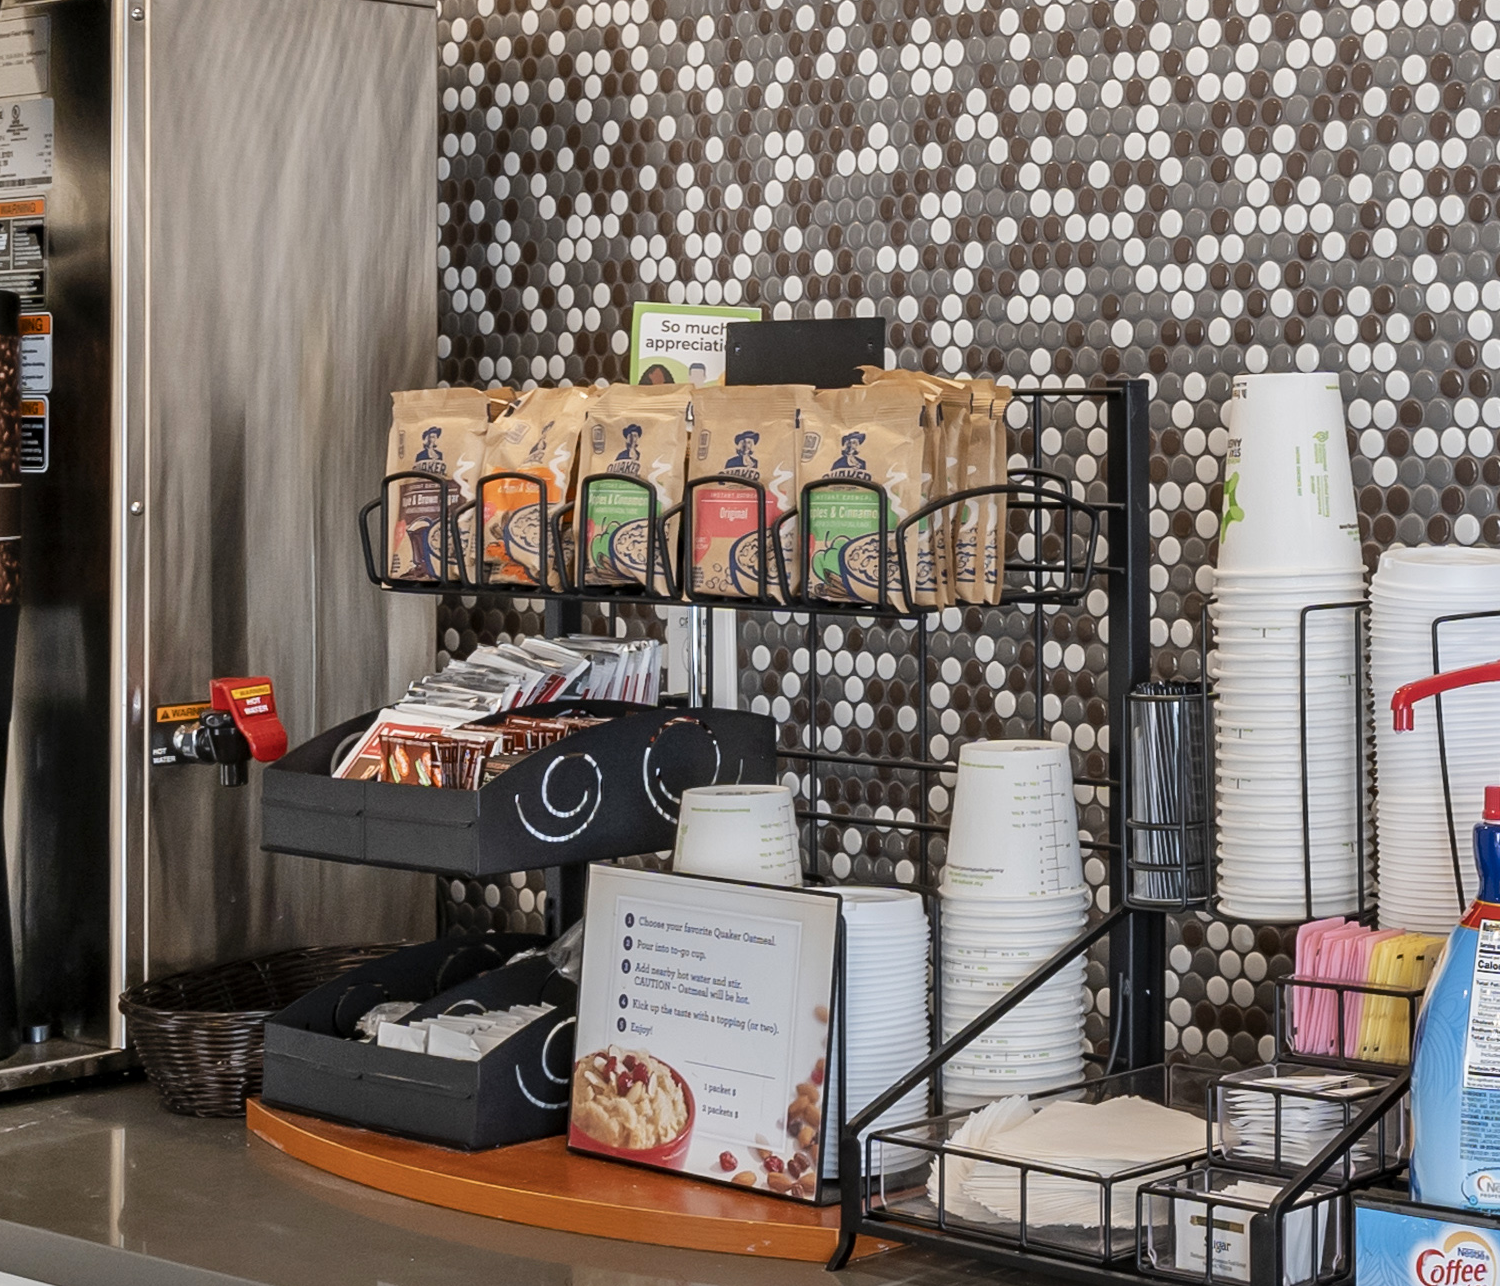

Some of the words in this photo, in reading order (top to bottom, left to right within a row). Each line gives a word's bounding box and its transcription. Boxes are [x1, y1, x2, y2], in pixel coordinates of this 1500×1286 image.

[1, 202, 36, 215] WARNING
[661, 320, 680, 333] So
[646, 338, 727, 353] appreciati
[417, 494, 440, 505] Brown
[719, 507, 749, 522] Original
[839, 506, 878, 519] Cinnamo
[246, 697, 260, 705] HOT
[153, 756, 176, 764] WATER
[638, 916, 665, 930] Choose
[666, 922, 683, 932] your
[684, 923, 713, 937] favorite
[714, 928, 742, 942] Quaker
[743, 932, 777, 946] Oatmeal.
[637, 939, 653, 951] Pour
[655, 943, 670, 954] into
[671, 946, 690, 958] to-go
[691, 950, 707, 961] cup.
[635, 963, 650, 975] Add
[651, 967, 676, 980] nearby
[677, 969, 689, 981] hot
[691, 974, 711, 984] water
[713, 974, 726, 986] and
[728, 978, 743, 989] stir.
[634, 976, 671, 991] CAUTION
[678, 983, 709, 998] Oatmeal
[710, 988, 724, 1000] will
[725, 991, 734, 1003] be
[735, 994, 750, 1005] hot.
[632, 999, 649, 1012] Kick
[650, 1003, 660, 1015] up
[661, 1004, 673, 1015] the
[674, 1008, 691, 1019] taste
[693, 1011, 709, 1023] with
[710, 1015, 715, 1023] a
[717, 1015, 745, 1030] topping
[747, 1019, 759, 1032] (or
[760, 1022, 779, 1036] two).
[630, 1022, 654, 1037] Enjoy!
[708, 1084, 731, 1096] packet
[707, 1105, 733, 1118] packets
